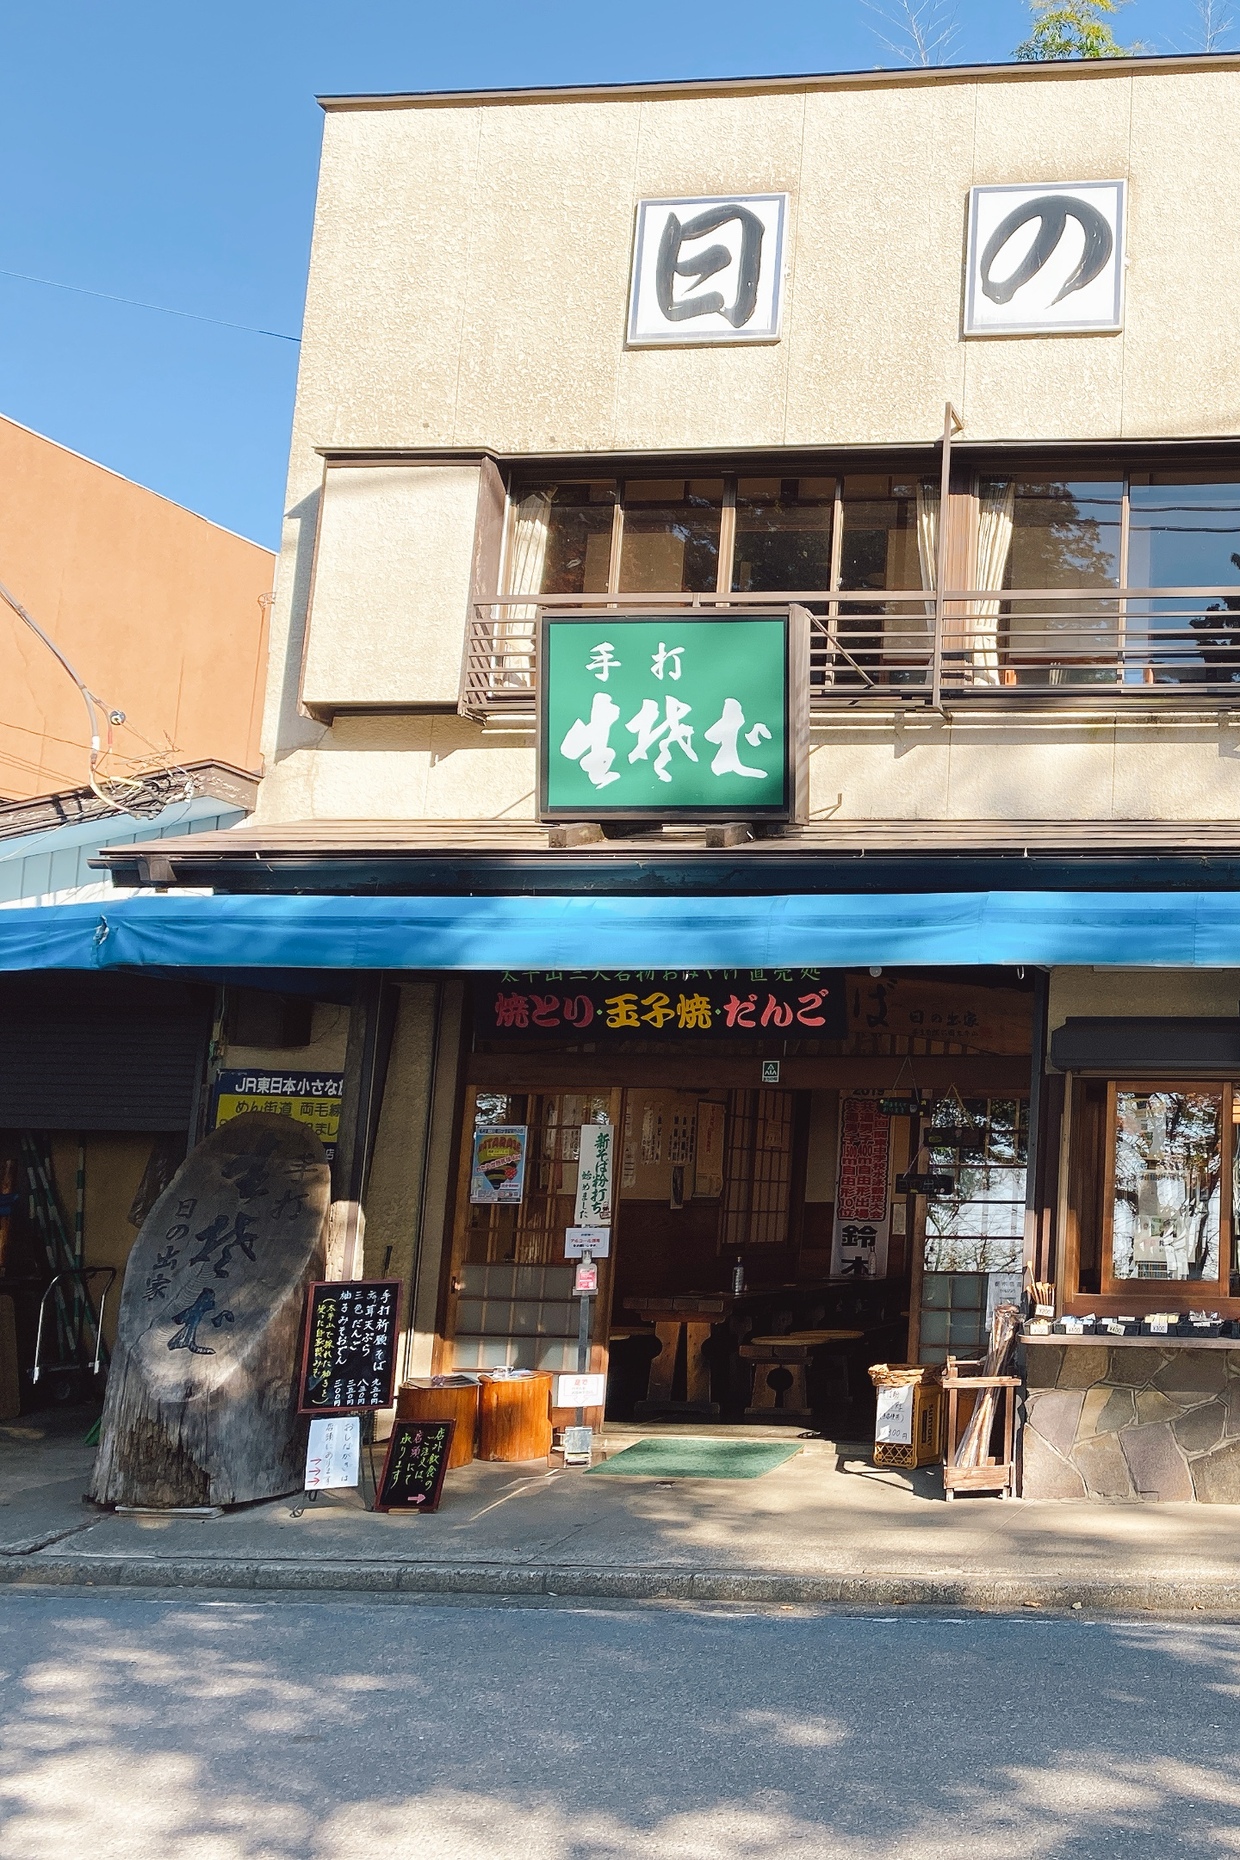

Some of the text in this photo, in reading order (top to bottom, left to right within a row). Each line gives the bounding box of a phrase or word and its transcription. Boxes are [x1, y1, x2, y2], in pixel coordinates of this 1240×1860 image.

[585, 641, 685, 682] 手打
[235, 1077, 342, 1096] JR東日本小さな
[590, 1132, 611, 1215] 新そば粉打ち
[142, 1197, 198, 1301] 日の出家
